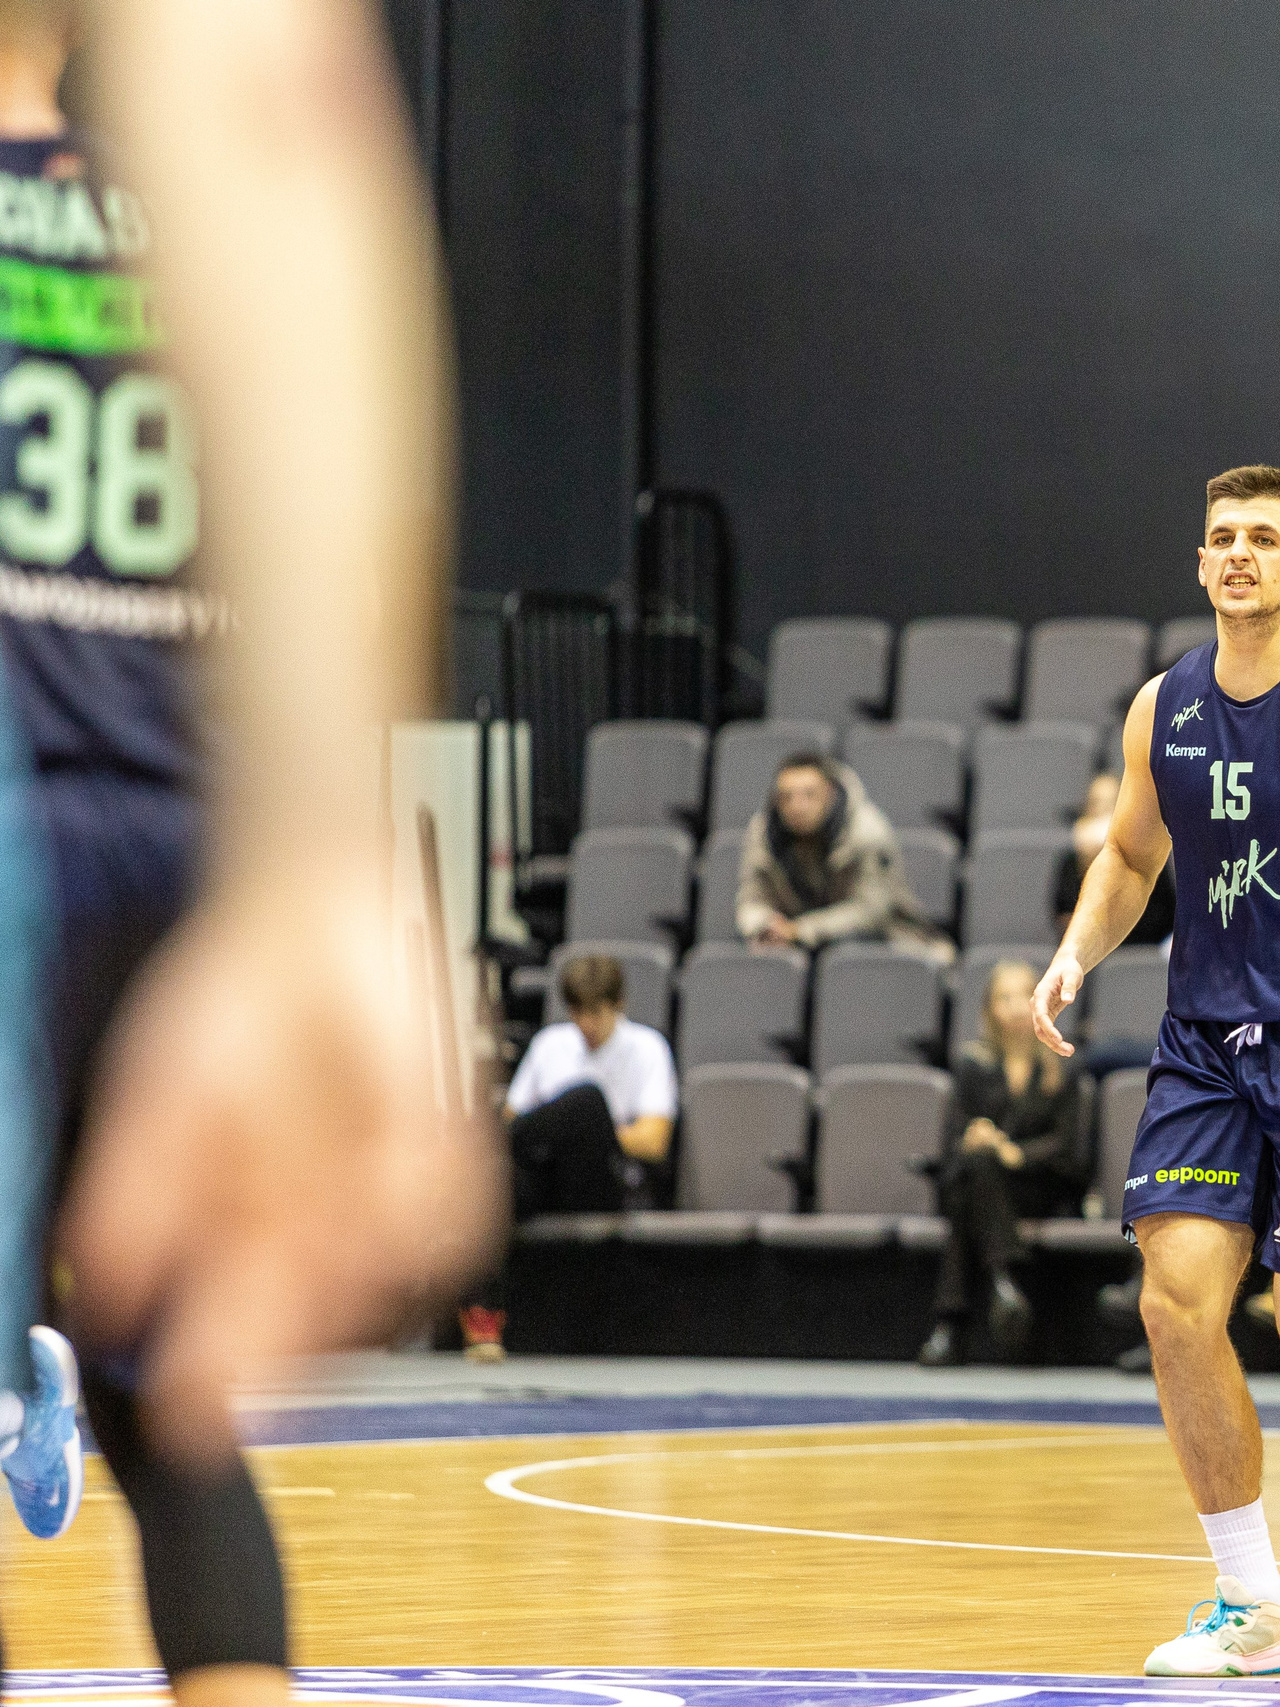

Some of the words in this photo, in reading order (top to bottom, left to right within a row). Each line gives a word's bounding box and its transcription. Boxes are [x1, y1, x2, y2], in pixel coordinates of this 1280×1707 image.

[0, 363, 198, 578] 38
[1165, 743, 1207, 760] Kempa
[1209, 760, 1253, 820] 15
[1155, 1166, 1240, 1186] евроопт
